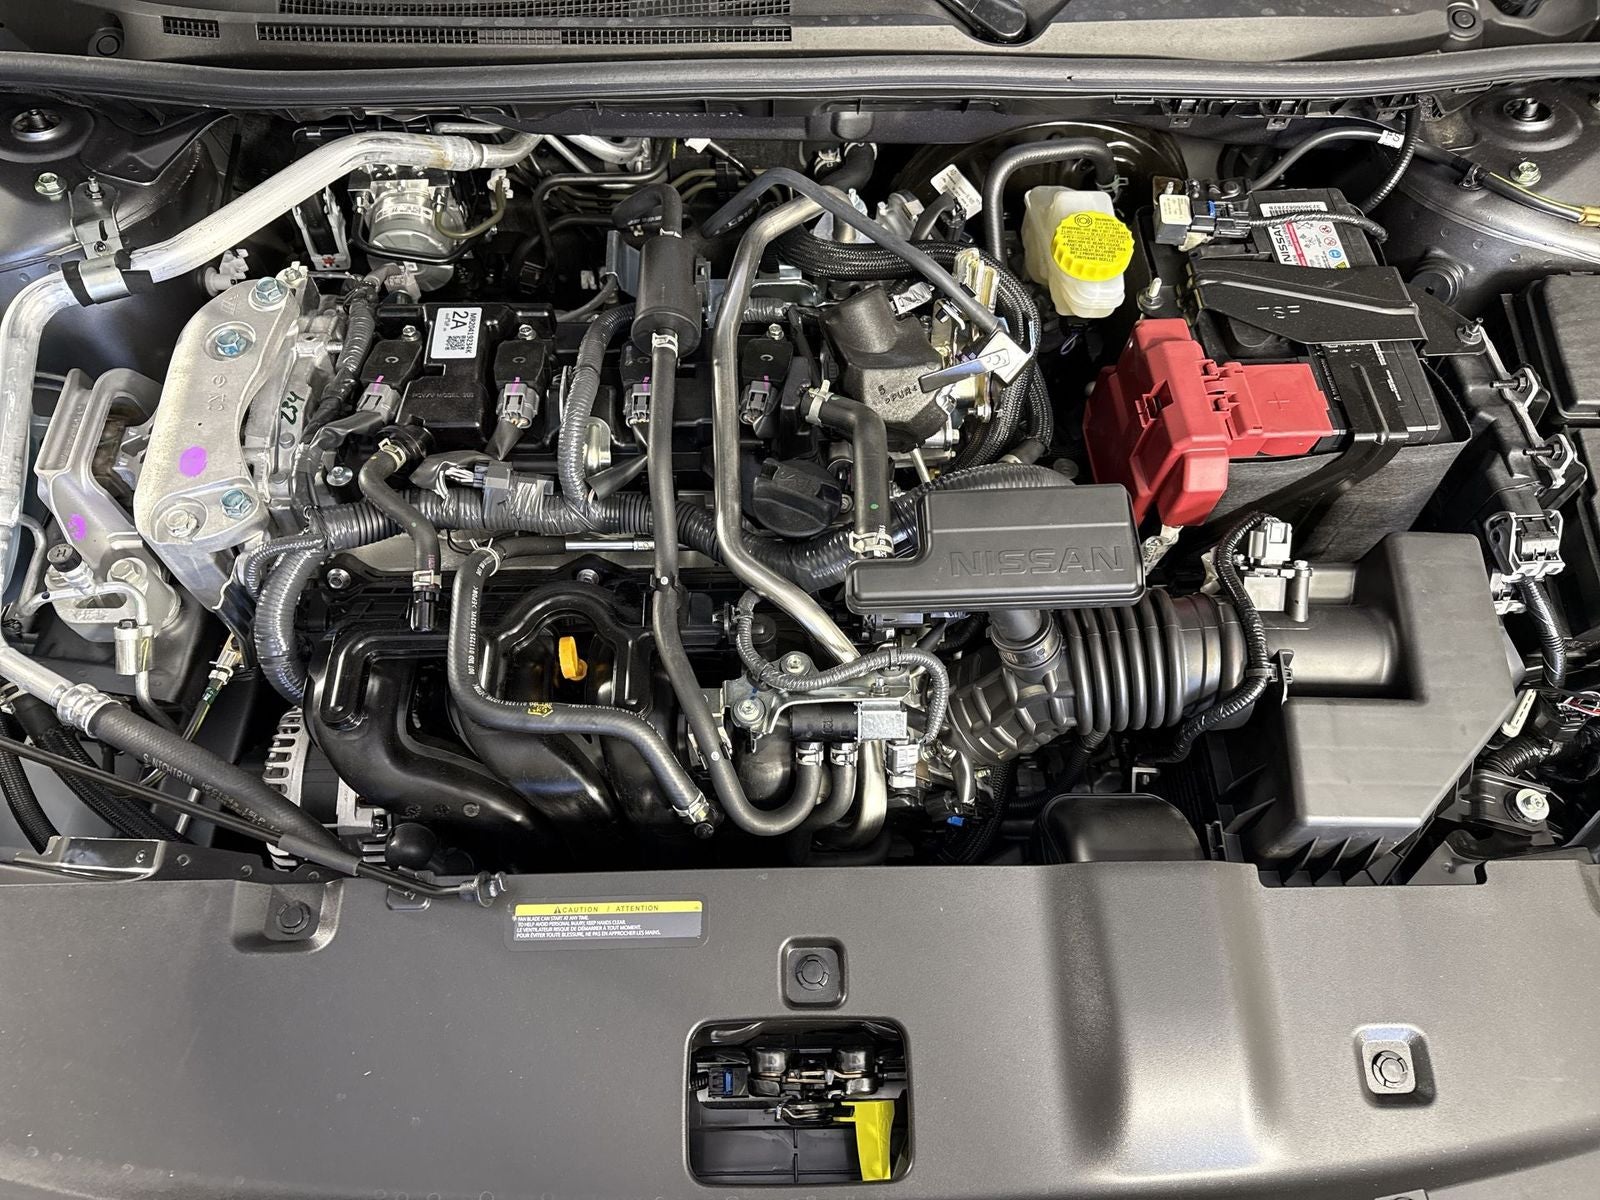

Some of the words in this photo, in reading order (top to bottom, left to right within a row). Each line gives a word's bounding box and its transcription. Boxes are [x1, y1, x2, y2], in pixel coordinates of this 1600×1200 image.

[450, 311, 469, 330] 2A
[949, 546, 1125, 577] NISSAN
[562, 906, 599, 914] CAUTION
[615, 905, 659, 913] ATTENTION
